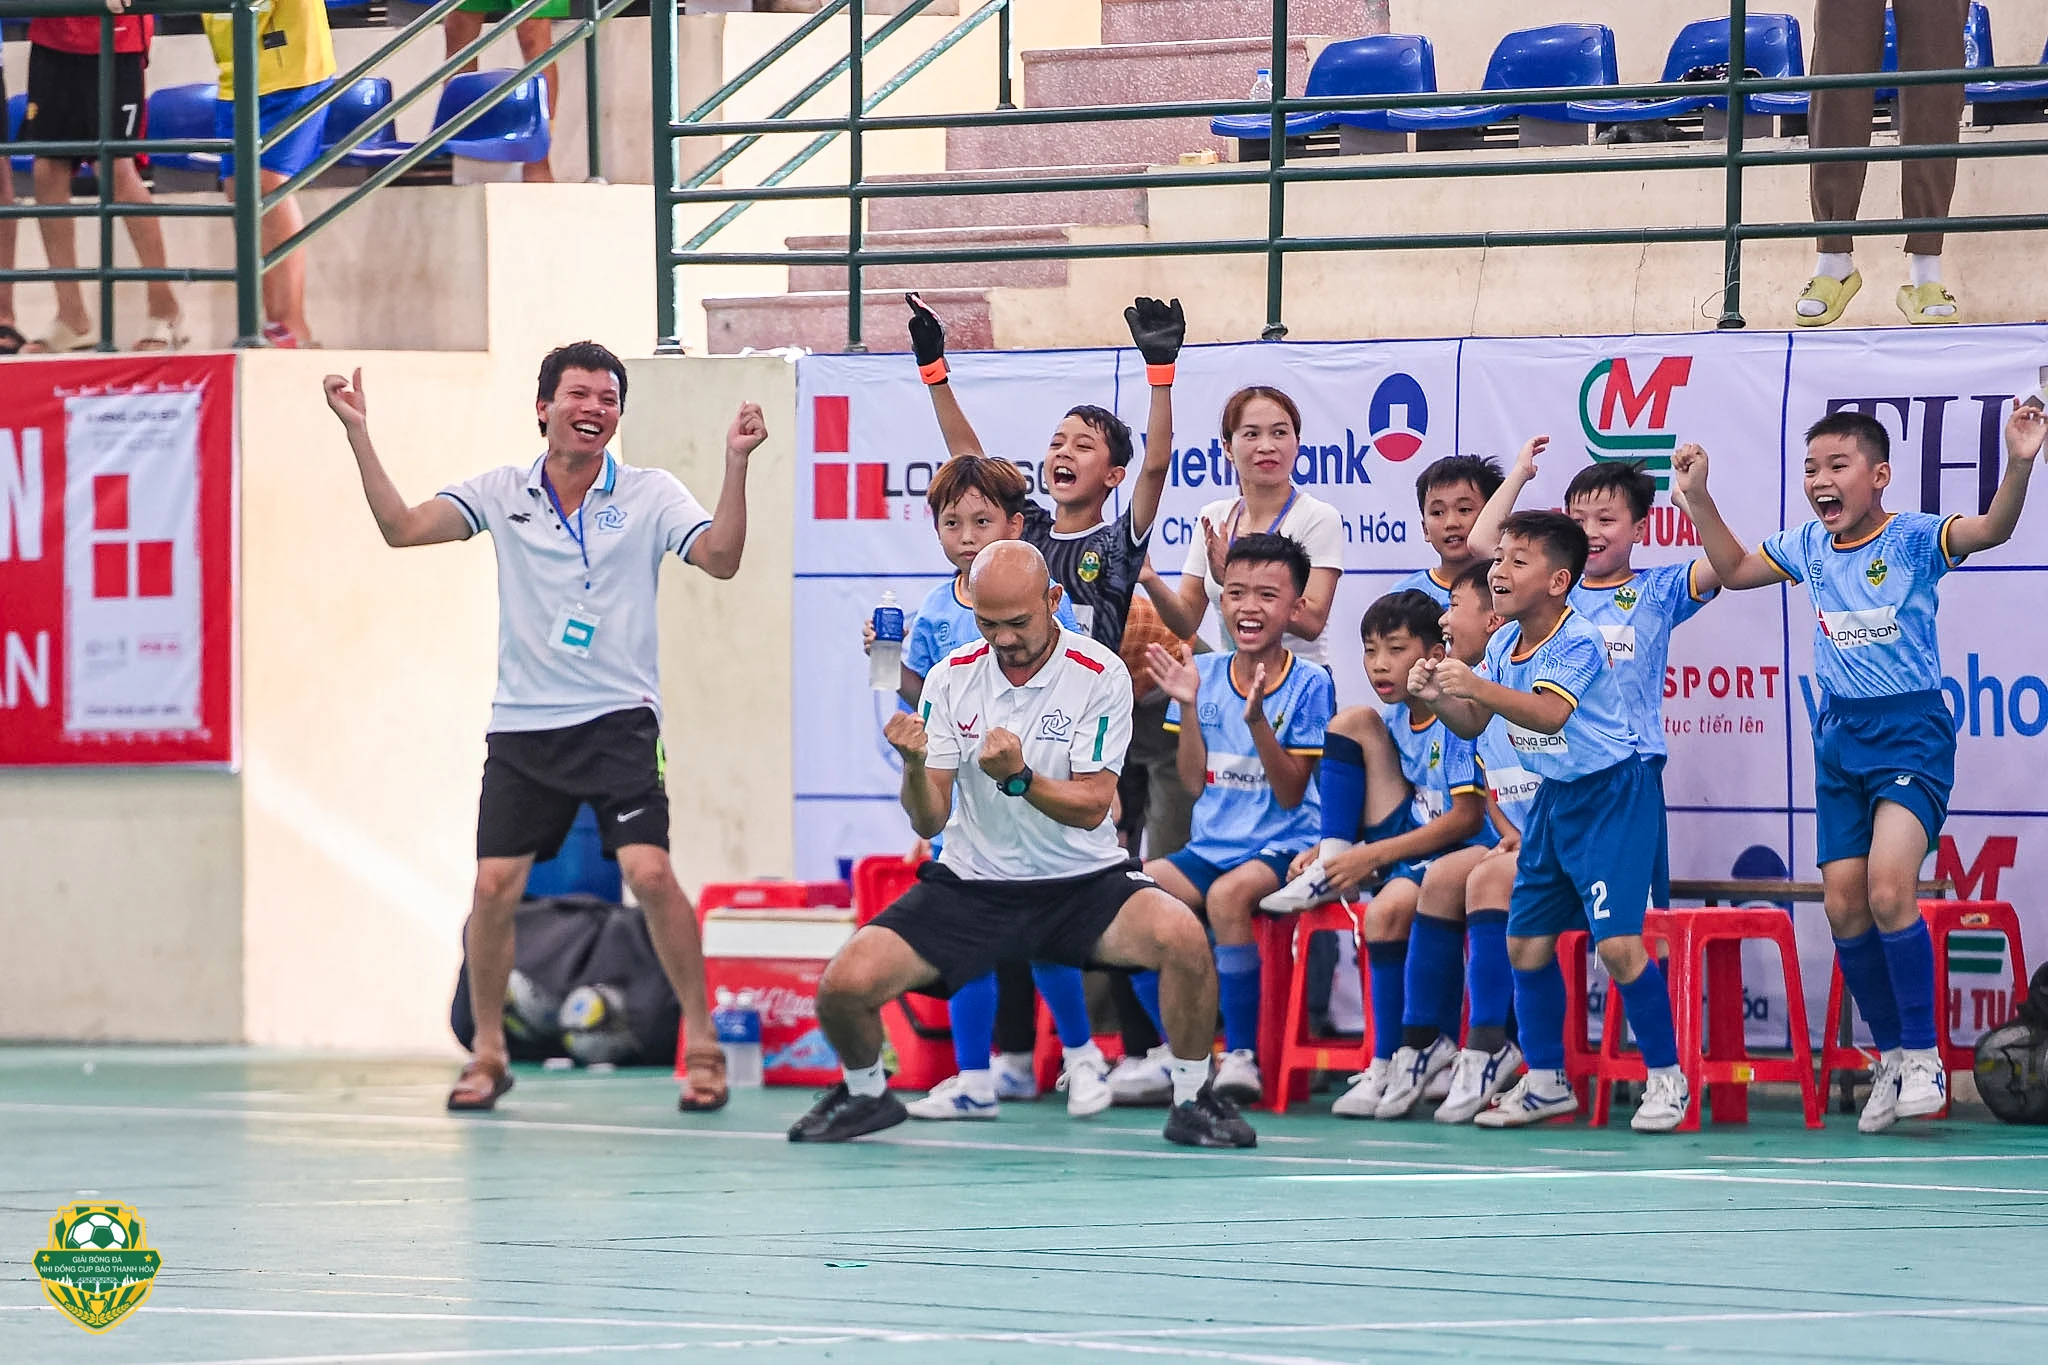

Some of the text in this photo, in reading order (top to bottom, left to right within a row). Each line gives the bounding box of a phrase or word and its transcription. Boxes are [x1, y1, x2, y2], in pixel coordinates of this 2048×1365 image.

[121, 103, 137, 137] 7
[1360, 511, 1406, 543] Hóa
[1869, 622, 1898, 638] SON
[0, 631, 49, 708] N
[1665, 713, 1764, 736] tục tiến lên
[1540, 736, 1567, 747] SON
[1591, 881, 1610, 920] 2
